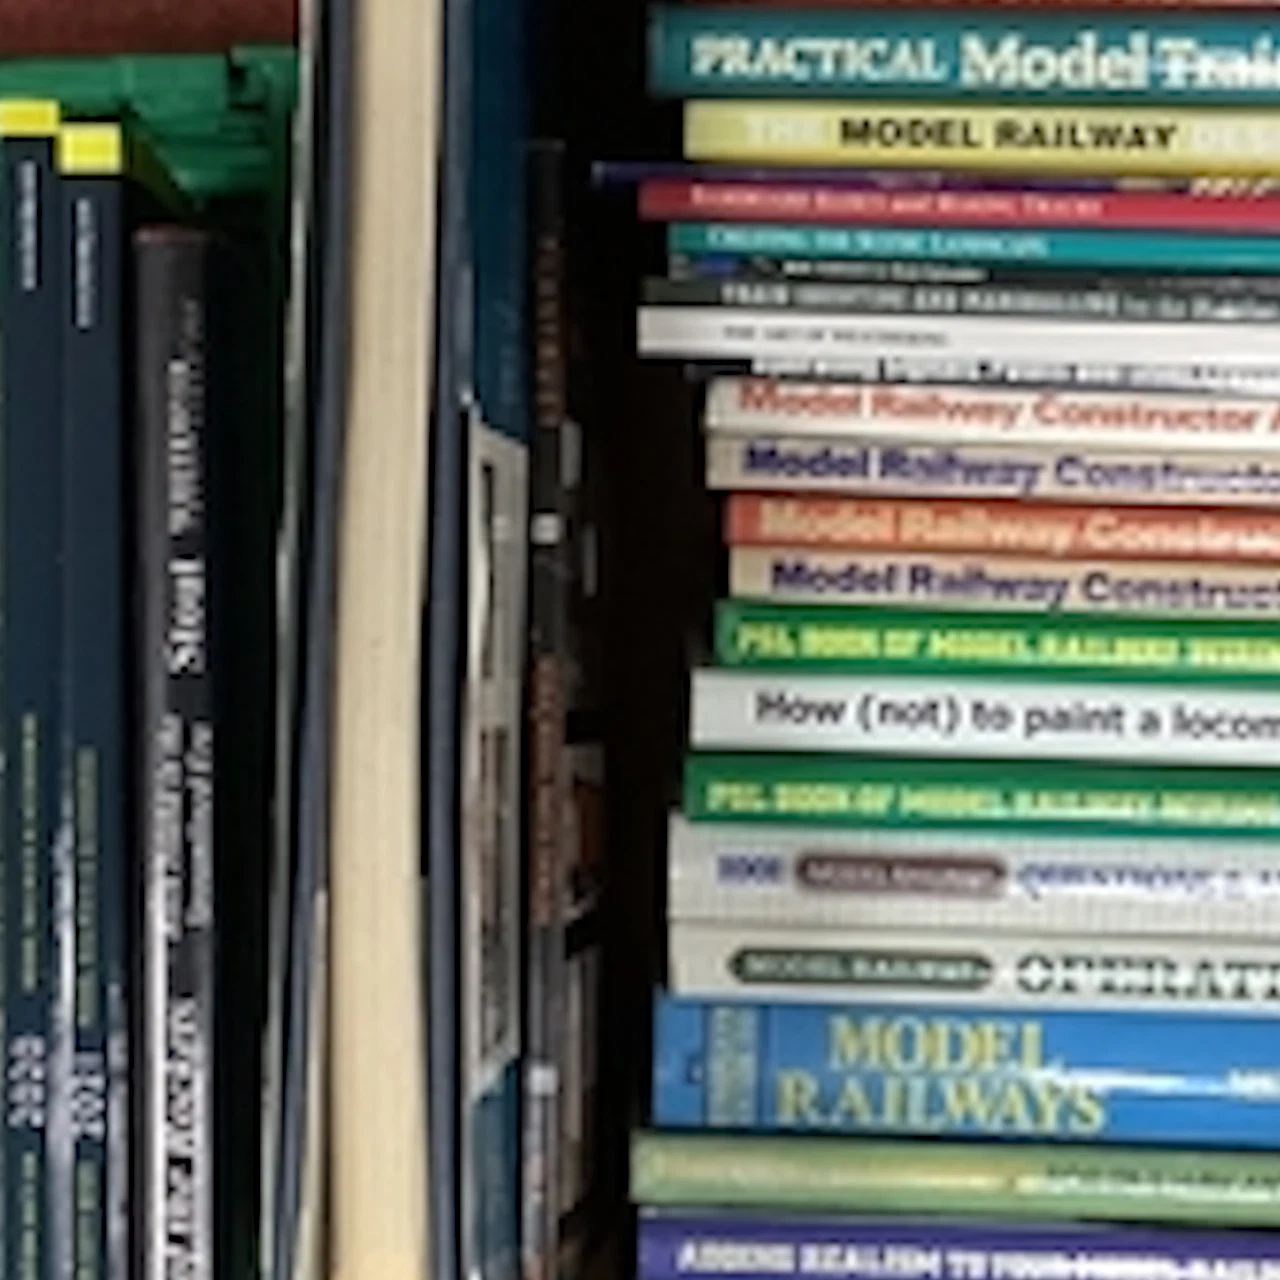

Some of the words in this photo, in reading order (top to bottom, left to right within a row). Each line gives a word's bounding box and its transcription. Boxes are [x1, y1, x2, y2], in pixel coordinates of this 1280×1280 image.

[690, 36, 946, 80] PRACTICAL
[959, 32, 1147, 88] Model
[838, 118, 980, 148] MODEL
[995, 120, 1176, 151] RAILWAY
[739, 381, 861, 413] Model
[872, 388, 1020, 430] Railway
[1032, 393, 1255, 431] Constructor
[742, 440, 869, 477] Model
[879, 446, 1042, 491] Railway
[759, 500, 894, 539] Model
[900, 504, 1077, 550] Railway
[770, 558, 901, 596] Model
[909, 564, 1070, 613] Railway
[755, 692, 846, 724] How
[857, 693, 962, 734] (not)
[970, 700, 1014, 729] to
[1024, 700, 1125, 740] paint
[1137, 709, 1162, 734] a
[829, 1014, 1046, 1072] MODEL
[776, 1068, 1106, 1133] RAILWAYS
